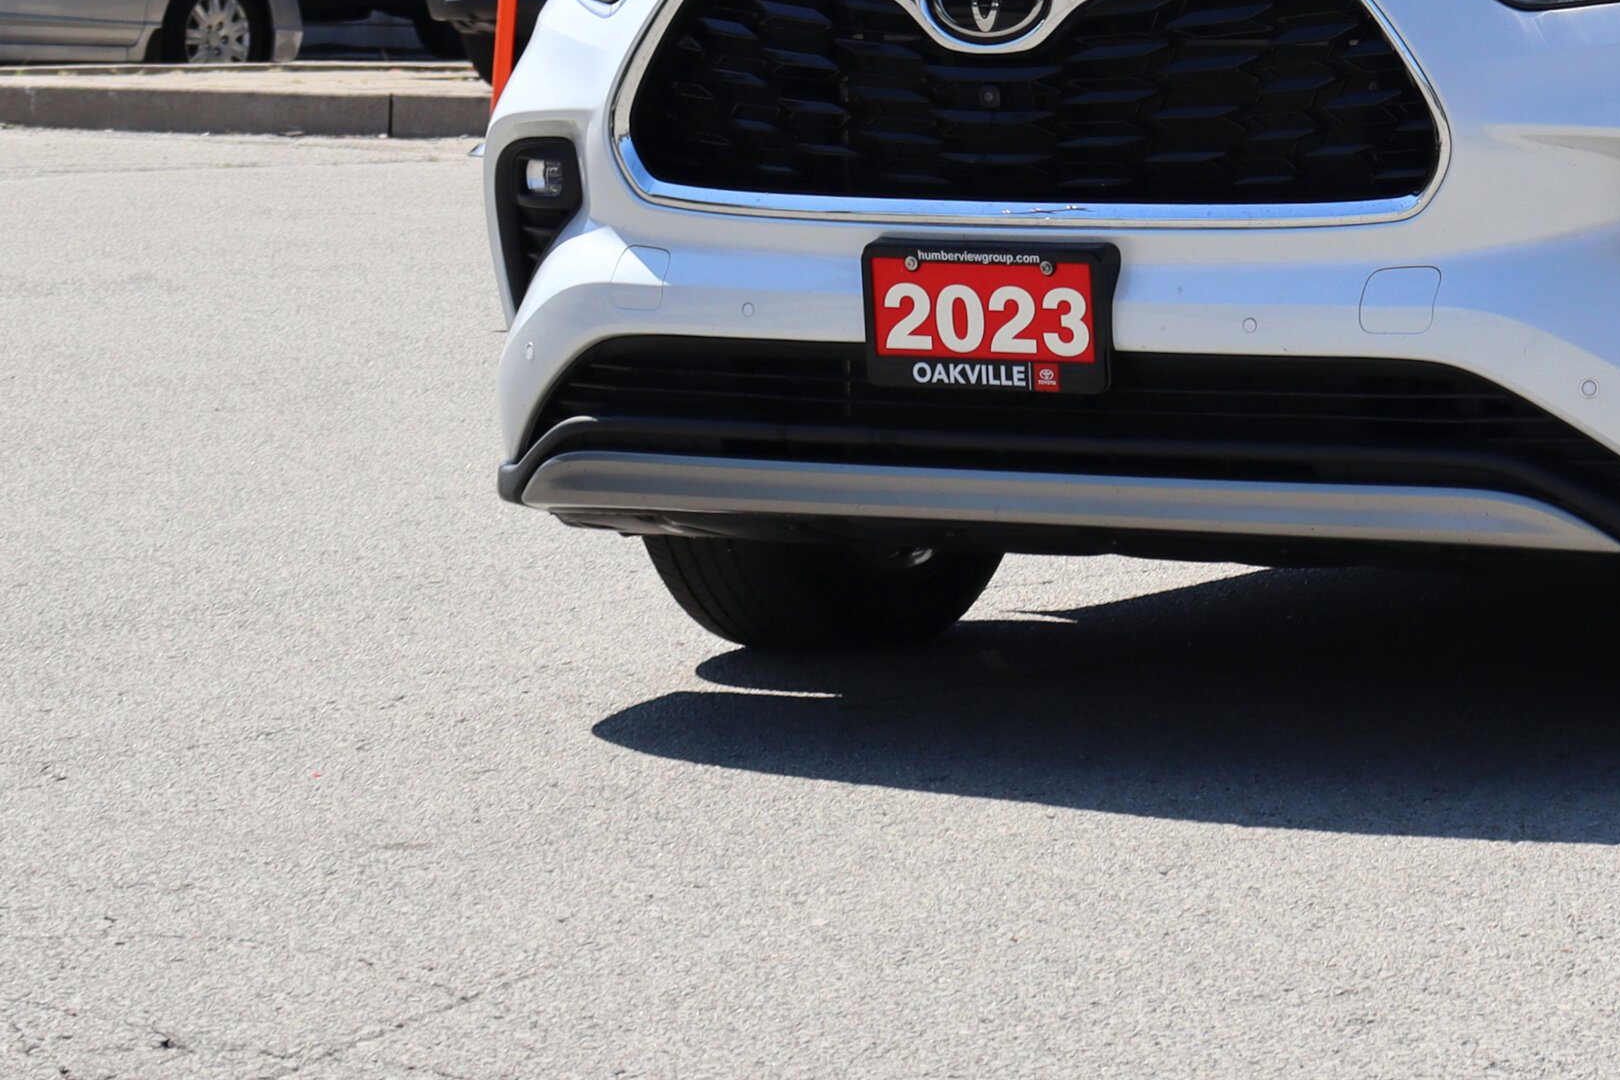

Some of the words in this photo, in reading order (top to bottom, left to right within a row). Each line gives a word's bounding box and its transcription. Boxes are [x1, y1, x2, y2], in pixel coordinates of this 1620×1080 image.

[917, 250, 1040, 265] humberviewgroup.com
[884, 281, 1090, 357] 2023
[912, 361, 1027, 387] OAKVILLE
